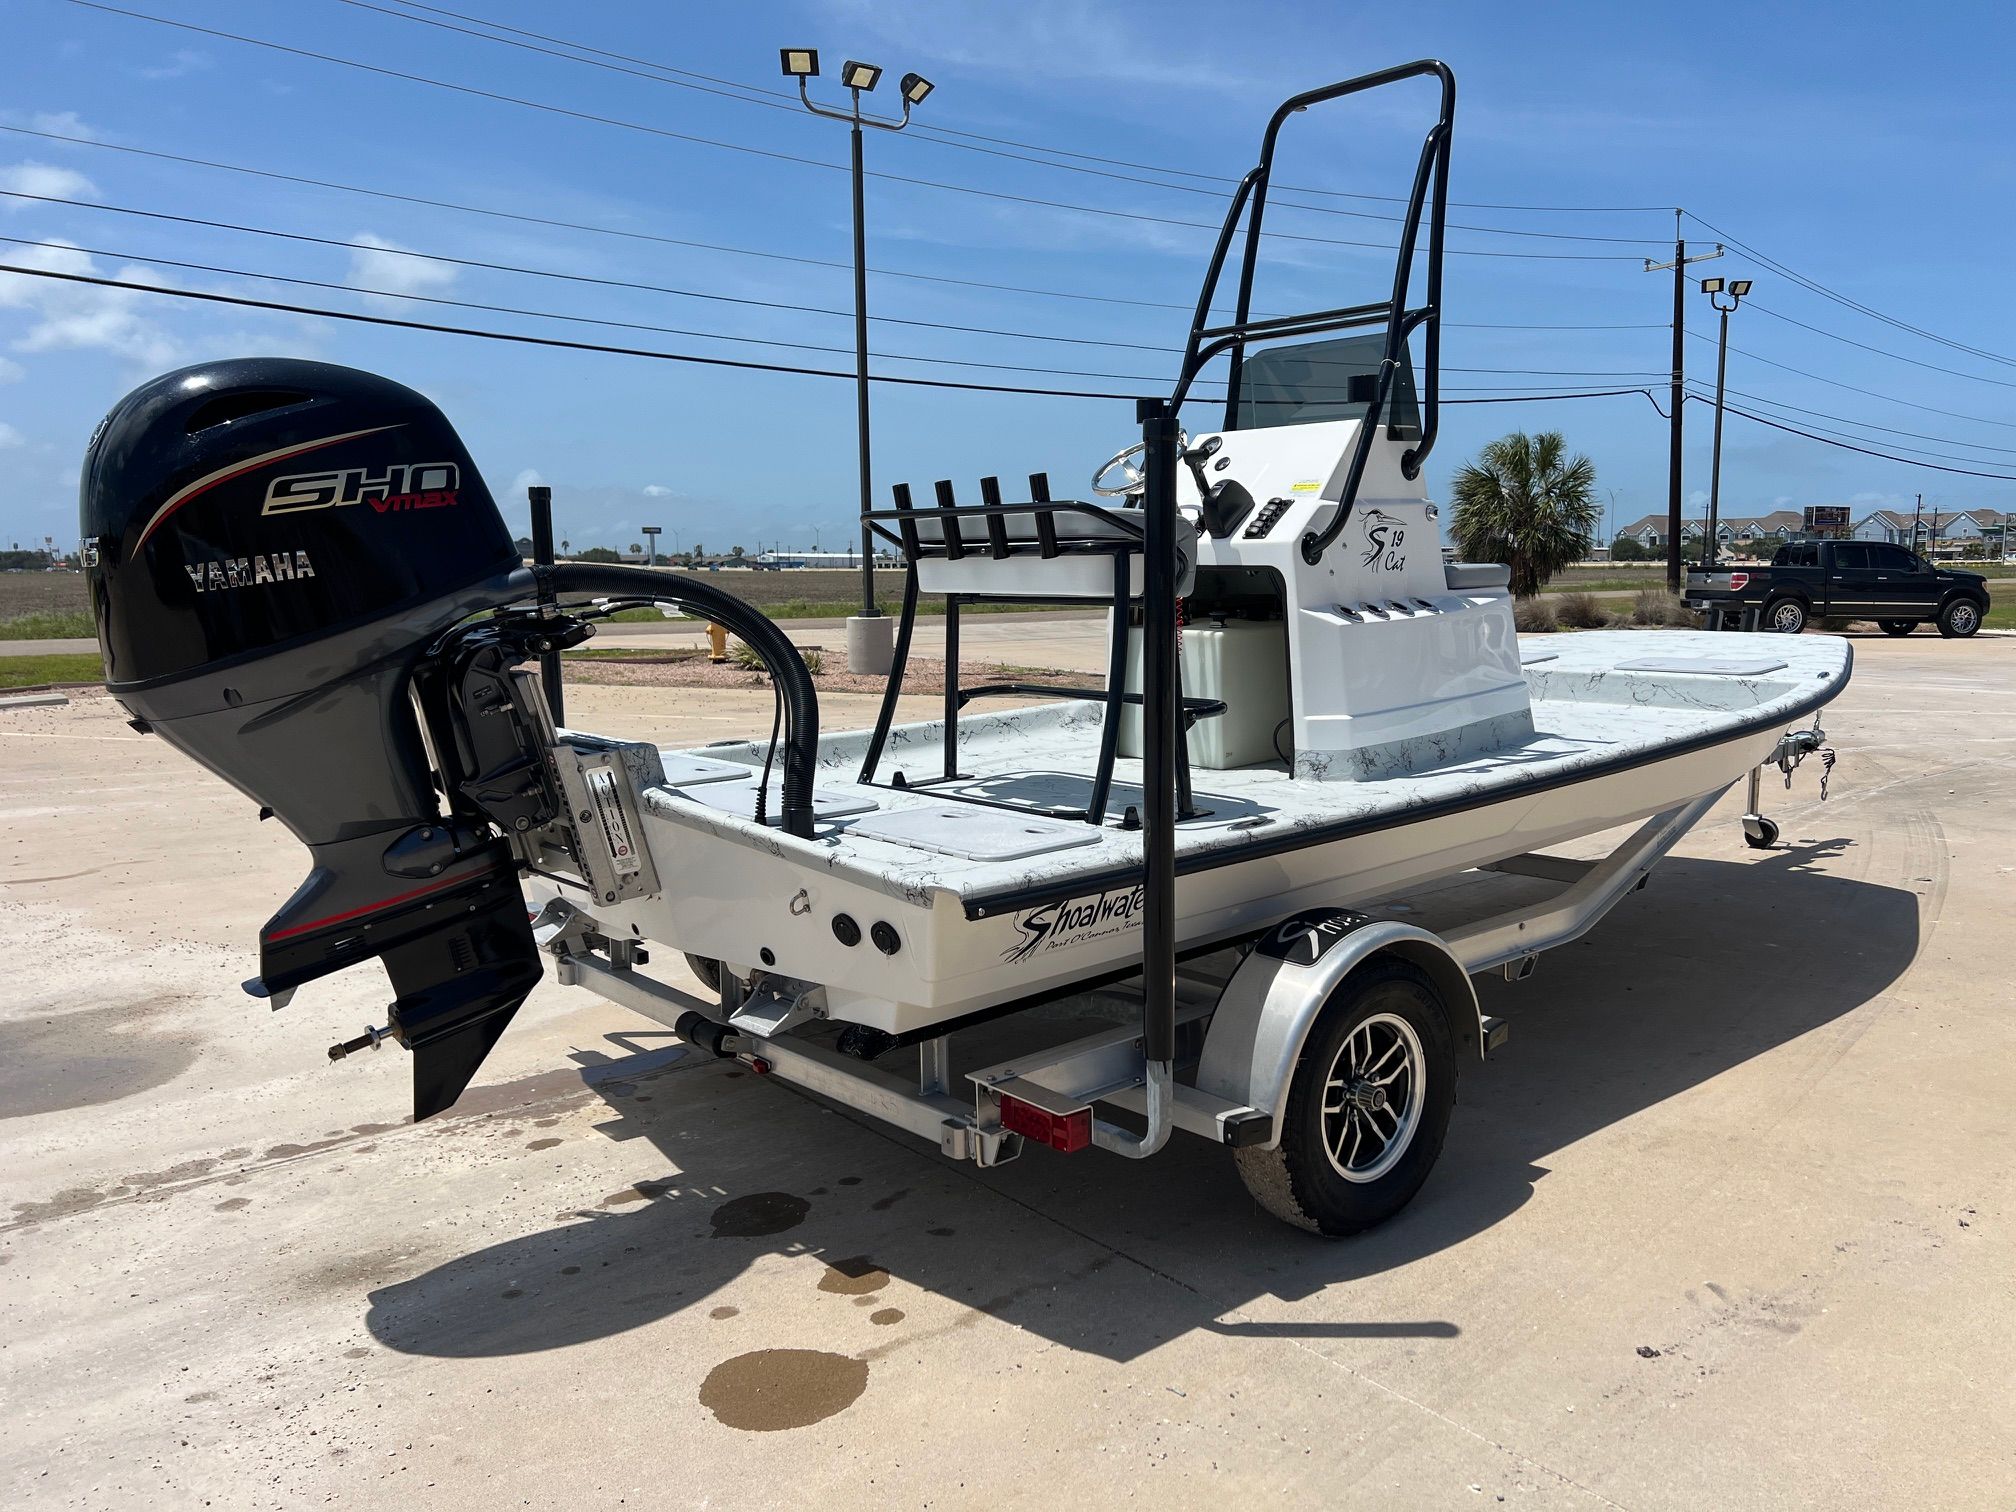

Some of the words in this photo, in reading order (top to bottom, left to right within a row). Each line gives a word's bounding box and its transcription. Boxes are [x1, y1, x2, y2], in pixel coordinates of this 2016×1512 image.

[261, 461, 460, 516] SHO
[1390, 530, 1405, 548] 19
[183, 550, 316, 592] YAMAHA
[1384, 551, 1406, 572] Cat
[1004, 883, 1145, 963] Shoalwate
